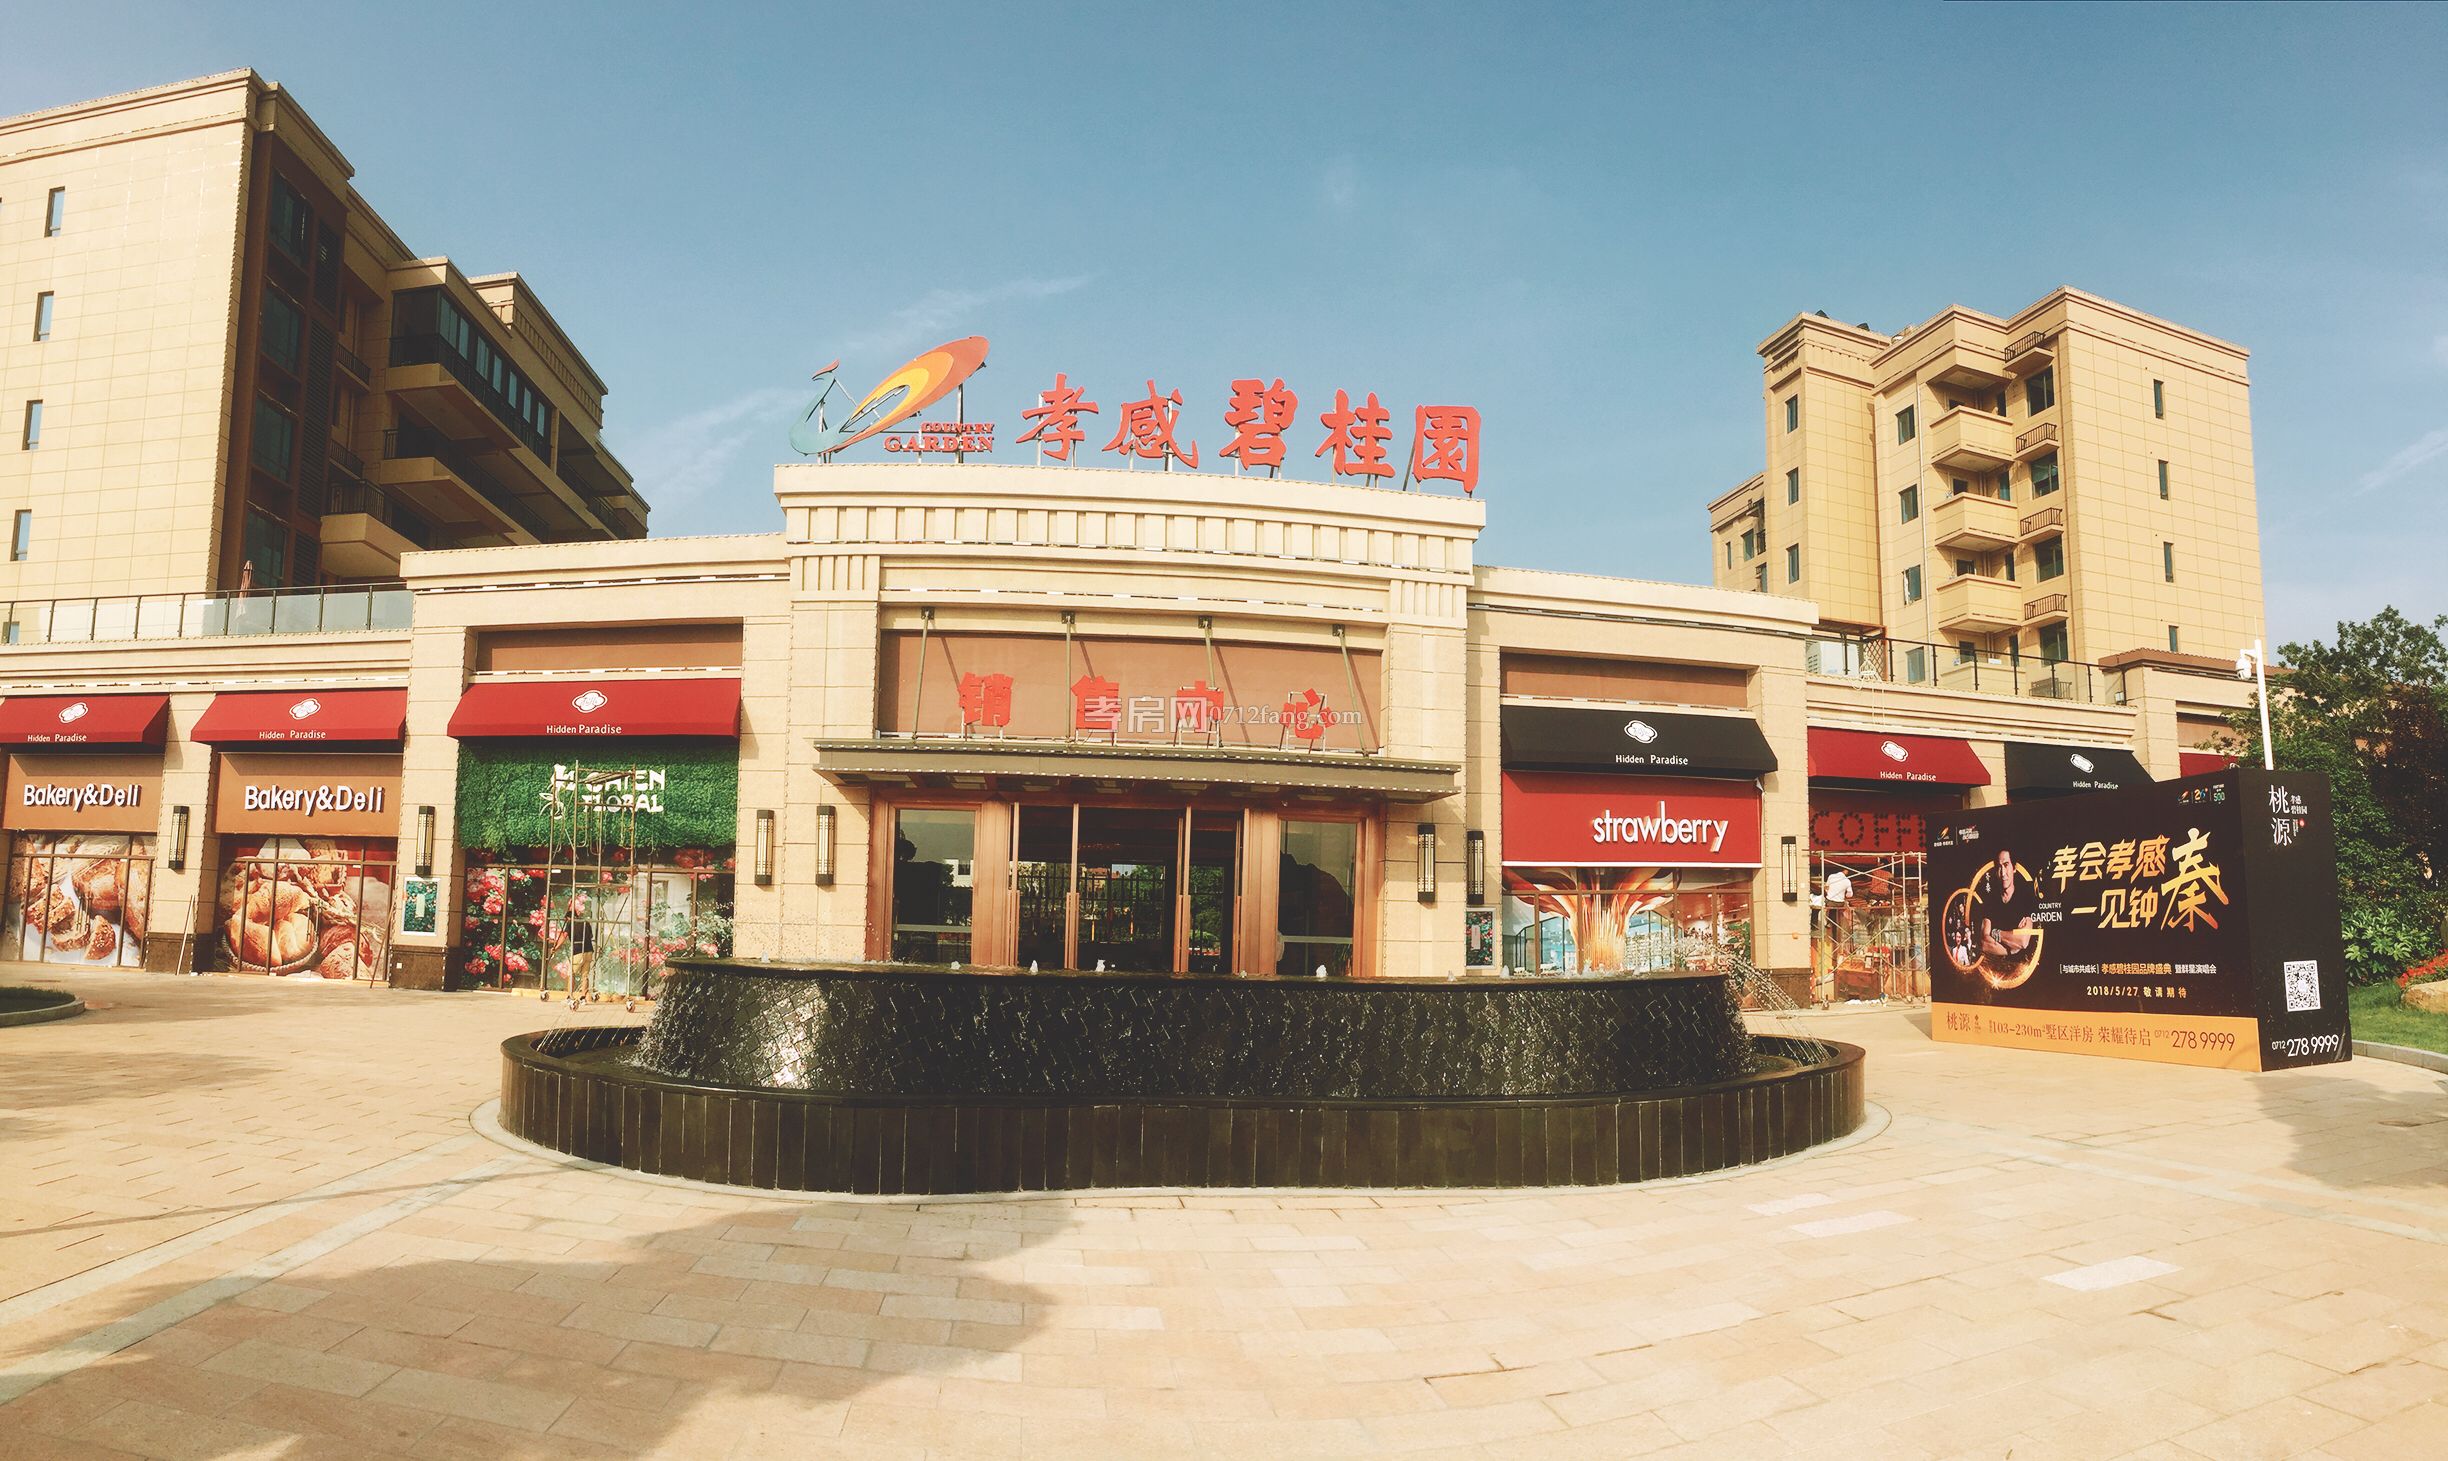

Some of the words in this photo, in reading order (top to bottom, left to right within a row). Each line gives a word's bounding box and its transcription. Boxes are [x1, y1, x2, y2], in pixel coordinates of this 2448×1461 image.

[920, 422, 995, 435] COUNTRY
[884, 435, 995, 453] GARDEN
[27, 734, 51, 742] Hidden
[54, 732, 87, 742] Paradise
[259, 730, 285, 739] Hidden
[289, 729, 327, 739] Paradise
[546, 724, 577, 734] Hidden
[578, 723, 622, 735] Paradise
[1615, 754, 1645, 764] Hidden
[1650, 754, 1689, 766] Paradise
[1880, 771, 1903, 780] Hidden
[1906, 772, 1937, 782] Paradise
[2072, 780, 2092, 789] Hidden
[2094, 781, 2119, 790] Paradise
[23, 783, 141, 813] Bakery&Deli
[244, 784, 385, 817] Bakery&Deli
[581, 793, 665, 813] FLORAL
[2268, 784, 2293, 847] 桃源
[1591, 800, 1729, 853] strawberry
[2051, 834, 2171, 894] 幸会孝感
[2038, 902, 2062, 910] COUNTRY
[2071, 886, 2159, 929] 一见钟
[2030, 911, 2063, 922] GARDEN
[2086, 985, 2139, 997] 2018/5/27
[2143, 986, 2188, 999] 敬请期待
[1946, 1011, 1971, 1032] 桃源
[2171, 1030, 2198, 1049] 278
[2199, 1032, 2236, 1052] 9999
[2271, 1040, 2287, 1051] 0712
[2287, 1038, 2310, 1057] 278
[2311, 1034, 2340, 1053] 9999
